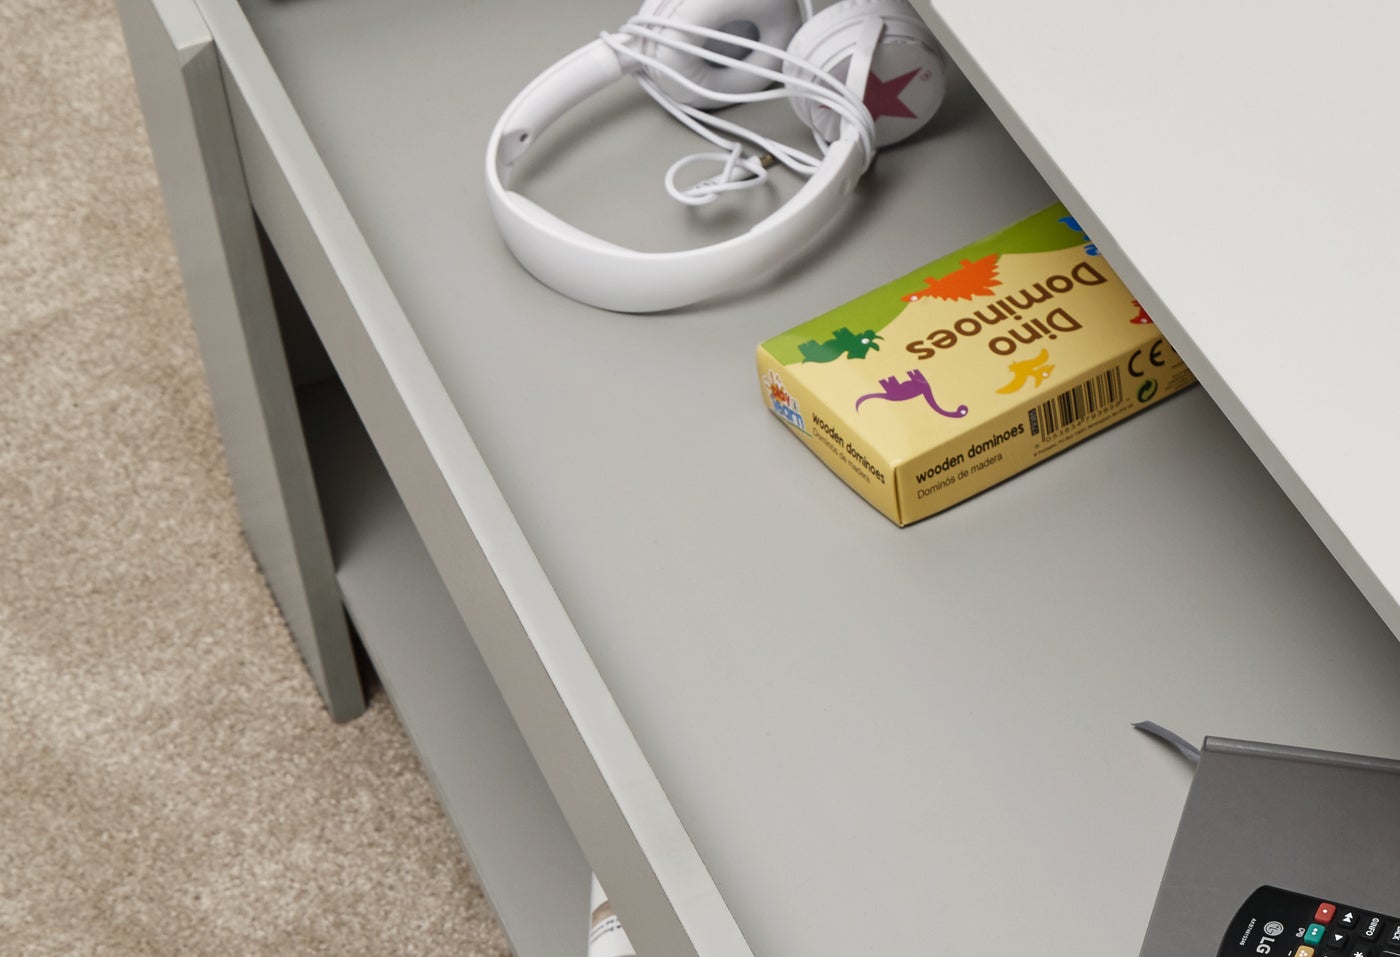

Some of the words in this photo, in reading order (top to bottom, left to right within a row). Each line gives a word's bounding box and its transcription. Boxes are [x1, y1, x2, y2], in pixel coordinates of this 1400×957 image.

[906, 261, 1108, 360] Dominoes
[988, 307, 1083, 356] Dino
[812, 412, 845, 448] wooden
[846, 442, 886, 485] dominoes
[916, 453, 965, 484] wooden
[968, 423, 1025, 459] dominoes
[917, 475, 956, 499] Dominós
[957, 466, 969, 480] de
[971, 453, 1003, 475] madera
[1256, 936, 1275, 954] LG
